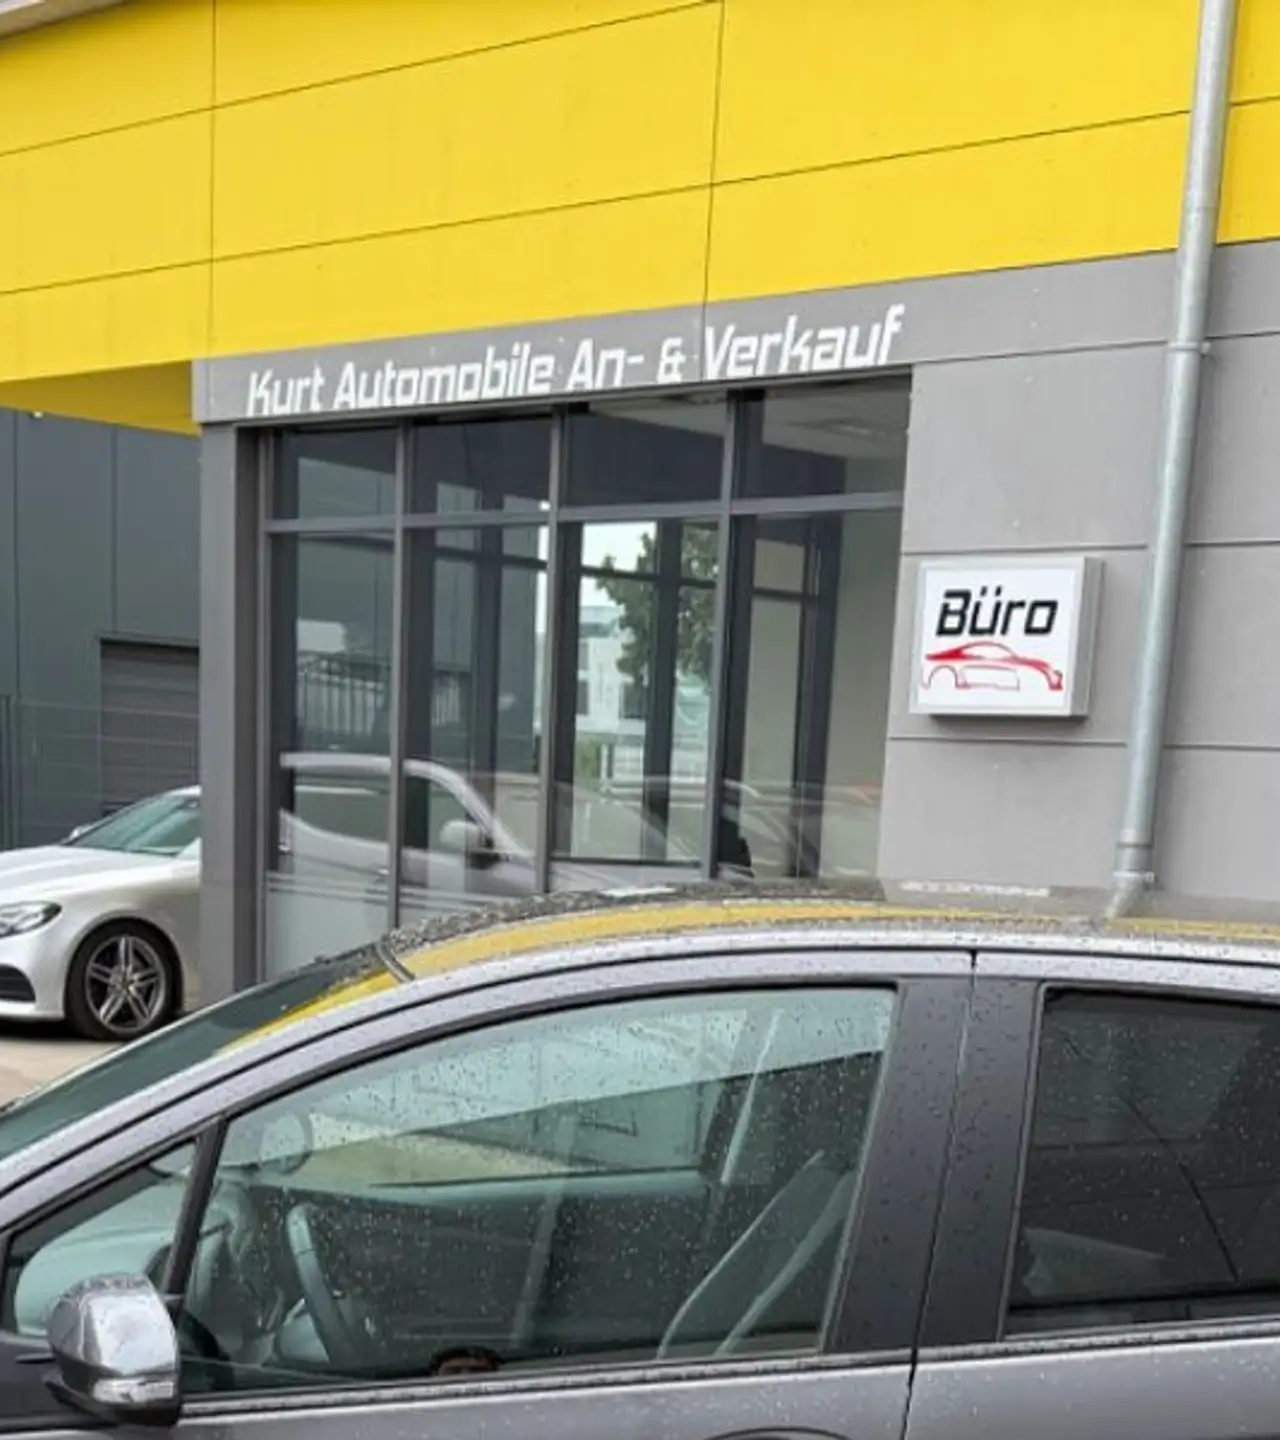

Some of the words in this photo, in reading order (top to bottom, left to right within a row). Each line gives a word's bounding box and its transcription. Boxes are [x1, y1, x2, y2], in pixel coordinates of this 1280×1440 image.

[246, 360, 325, 417] Kurt
[333, 342, 555, 410] Automobile
[564, 338, 646, 391] An-
[656, 337, 687, 383] &
[704, 303, 906, 381] Verkauf
[935, 585, 1059, 637] Büro
